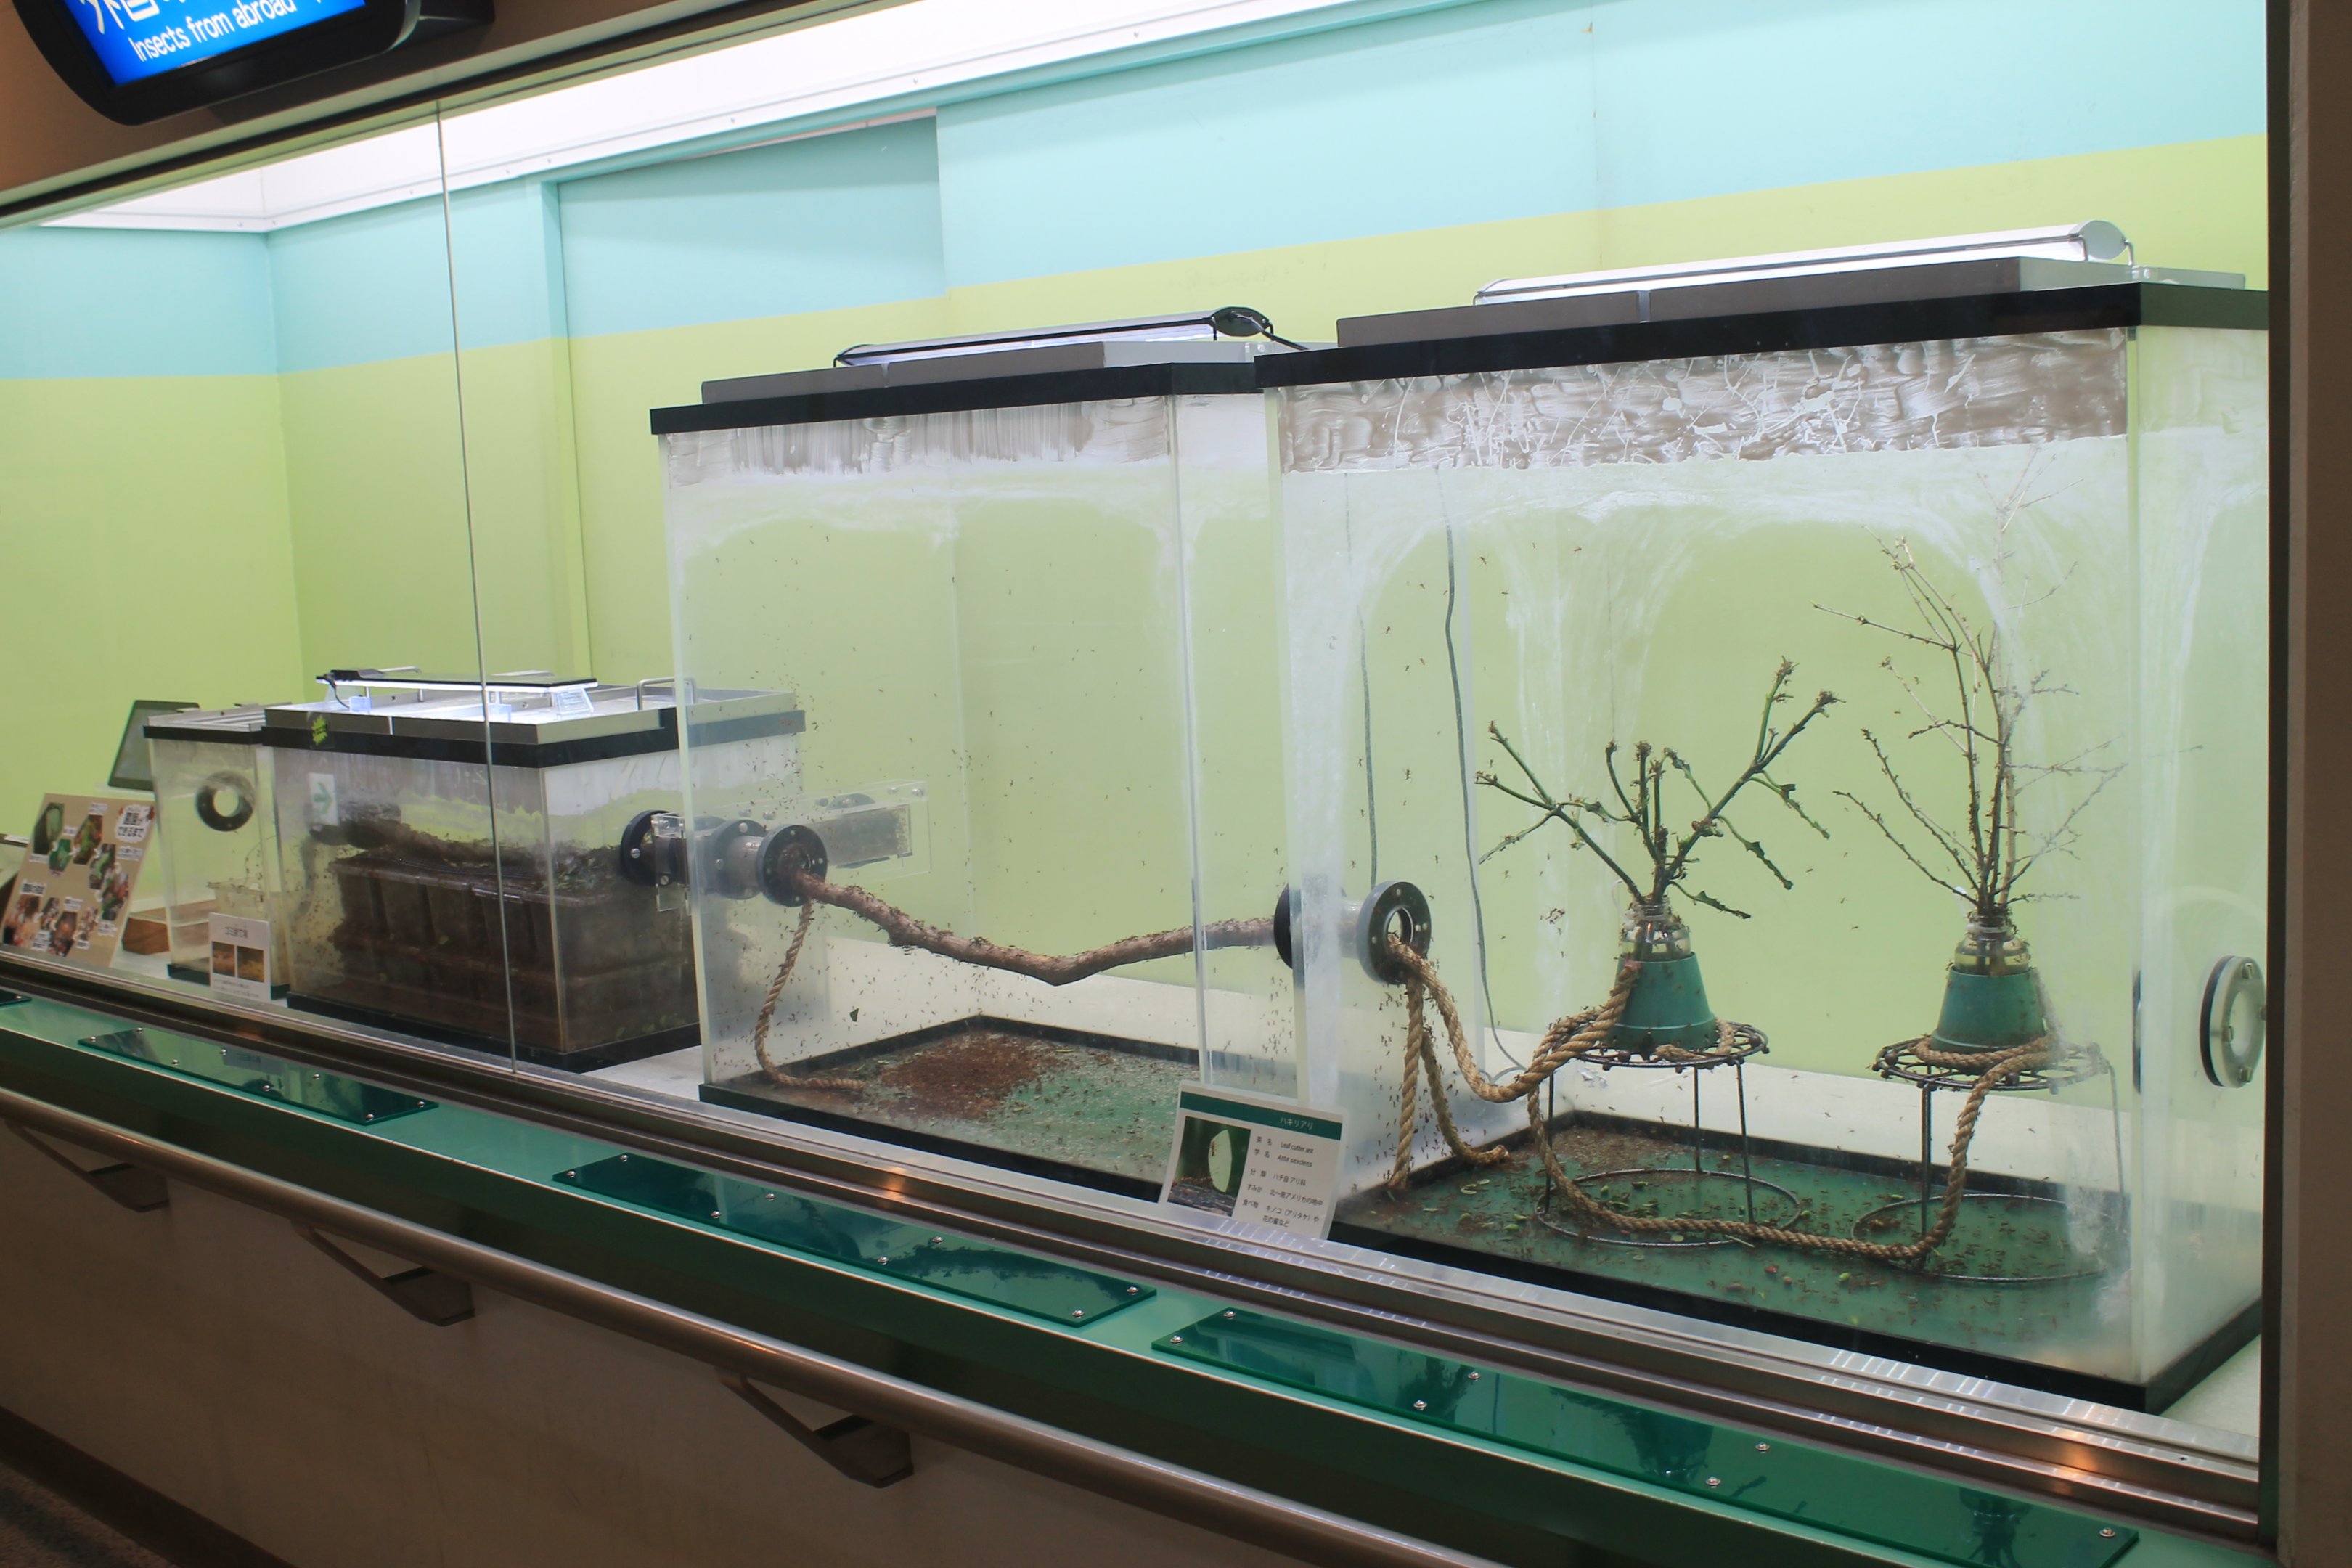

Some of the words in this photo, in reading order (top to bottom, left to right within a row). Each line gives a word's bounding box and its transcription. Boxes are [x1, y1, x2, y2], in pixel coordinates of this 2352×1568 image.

[128, 27, 191, 62] Insects
[187, 15, 235, 44] from
[1280, 1117, 1313, 1130] ハキリアリ
